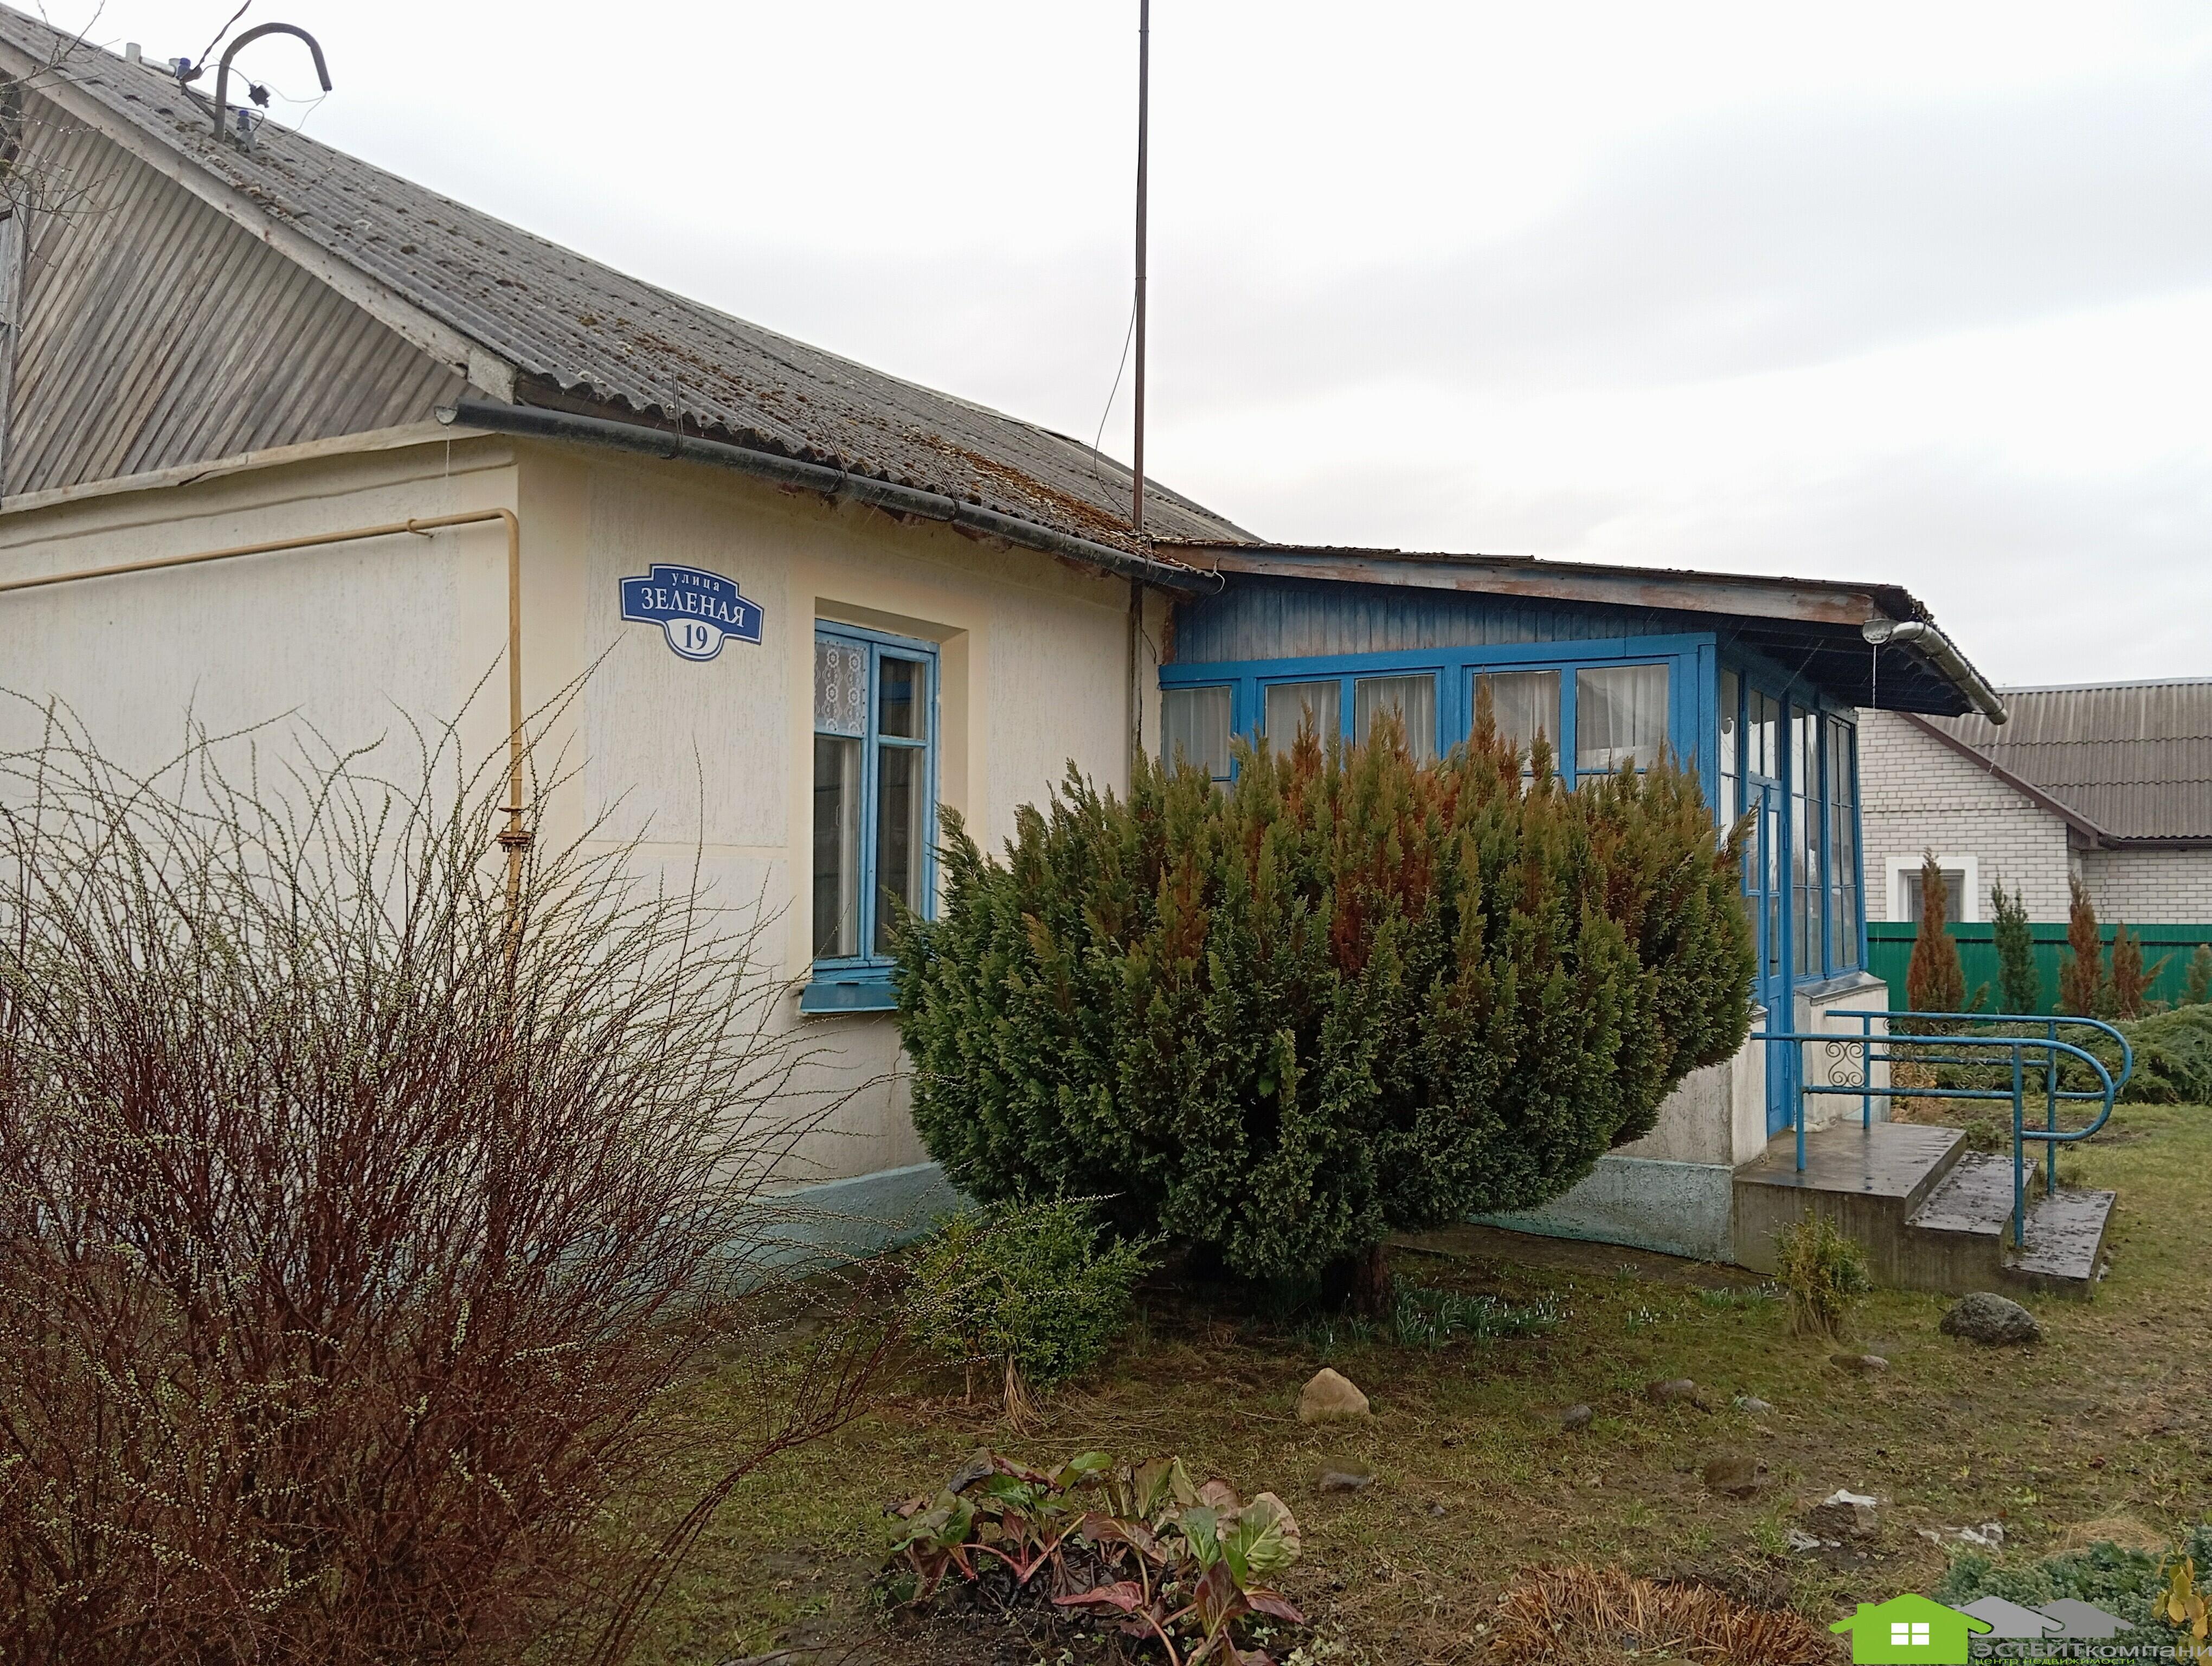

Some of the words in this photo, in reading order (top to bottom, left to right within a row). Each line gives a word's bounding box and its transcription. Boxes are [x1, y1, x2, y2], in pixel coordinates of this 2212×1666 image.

[672, 573, 720, 592] улица
[641, 587, 746, 627] ЗЕЛЕНАЯ
[684, 624, 708, 650] 19
